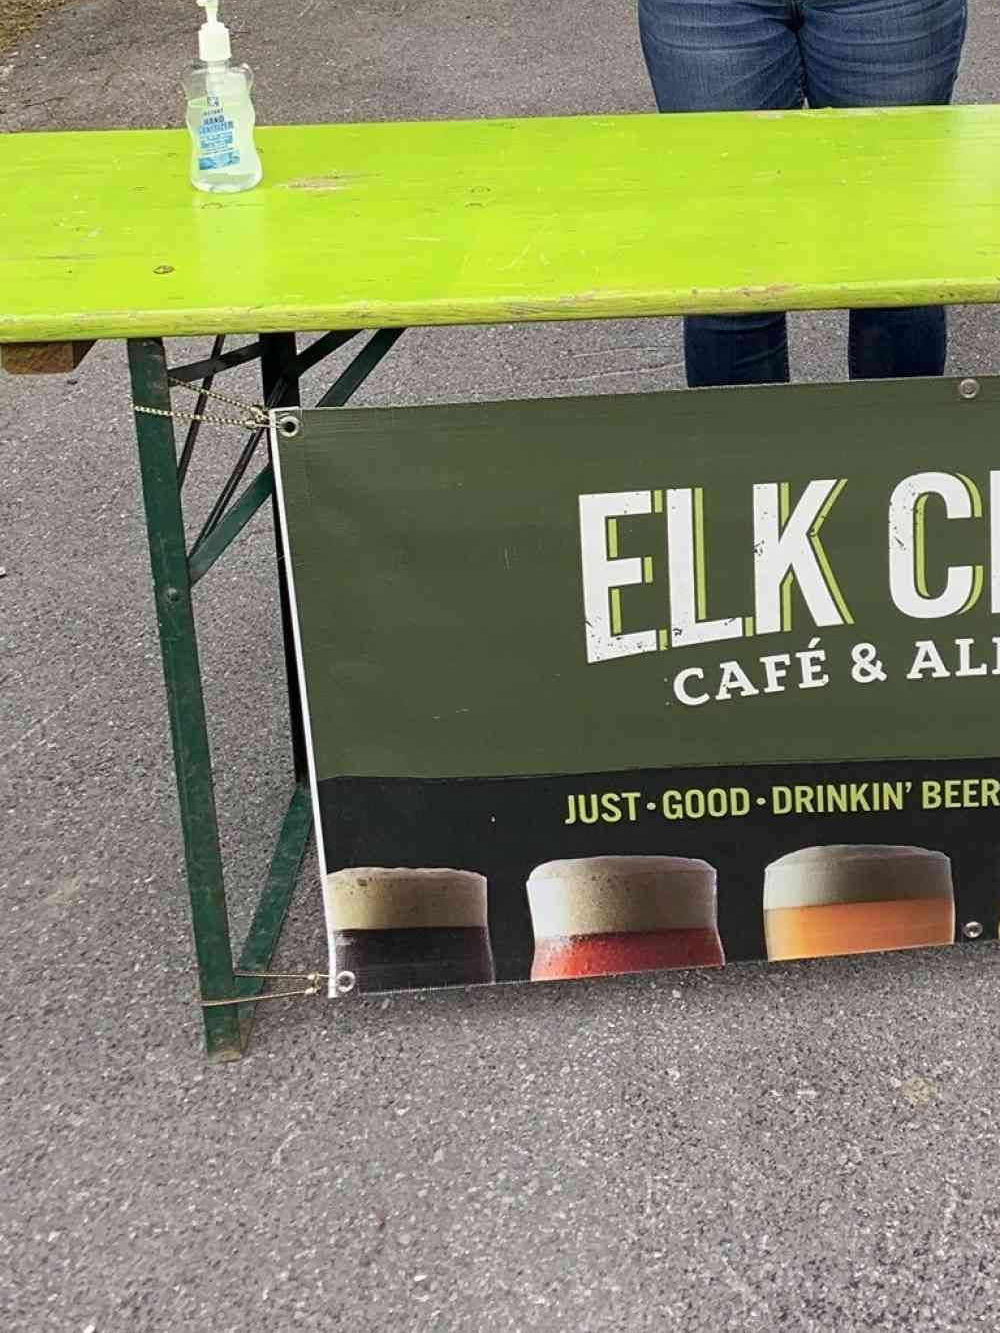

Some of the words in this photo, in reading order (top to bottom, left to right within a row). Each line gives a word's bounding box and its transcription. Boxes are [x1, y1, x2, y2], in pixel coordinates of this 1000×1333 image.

[578, 477, 856, 664] ELK
[673, 637, 830, 706] CAFÉ
[850, 641, 887, 682] &
[564, 792, 641, 825] JUST
[661, 788, 750, 820] GOOD
[771, 780, 913, 815] DRINKIN'
[921, 778, 1000, 810] BEER
